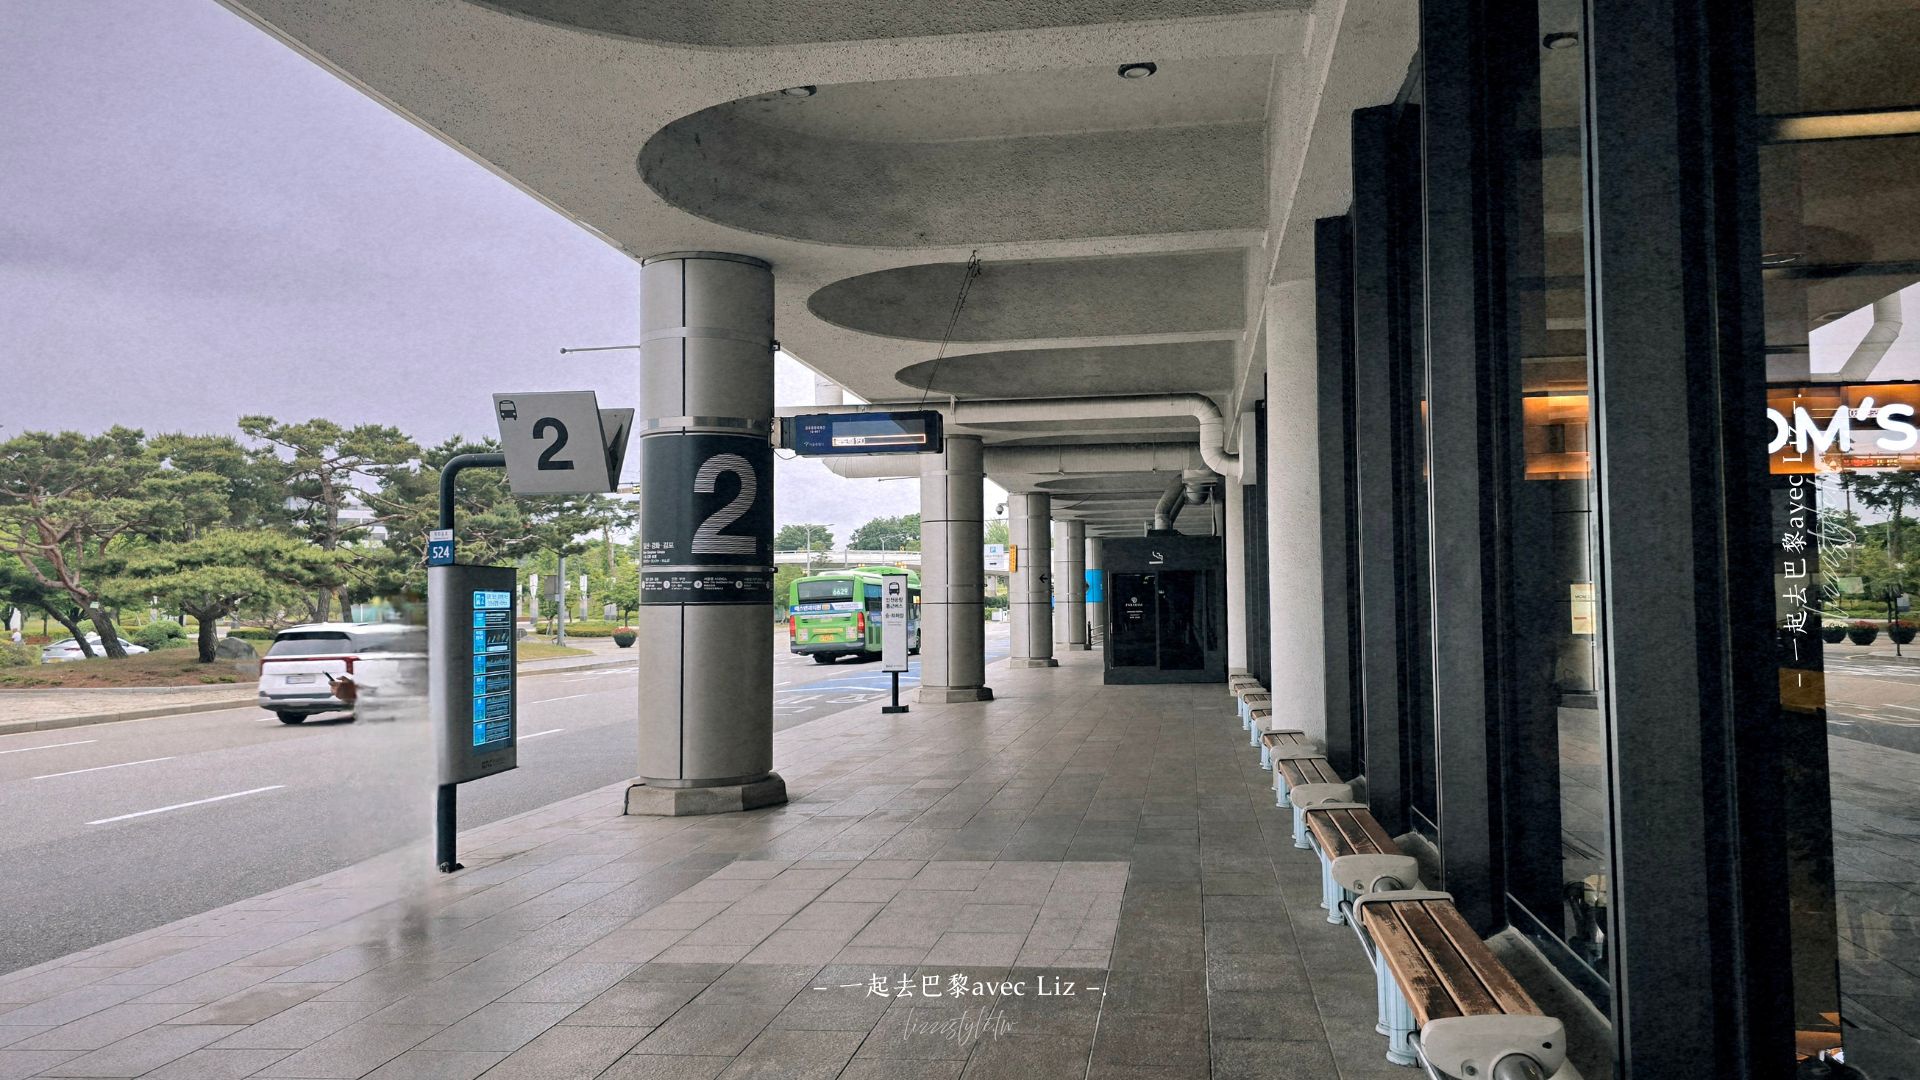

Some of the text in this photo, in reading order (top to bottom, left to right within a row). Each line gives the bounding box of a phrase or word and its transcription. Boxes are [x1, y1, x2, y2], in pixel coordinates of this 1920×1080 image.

[532, 417, 574, 471] 2
[691, 453, 757, 554] 2
[432, 546, 450, 559] 524
[832, 587, 848, 596] 6629
